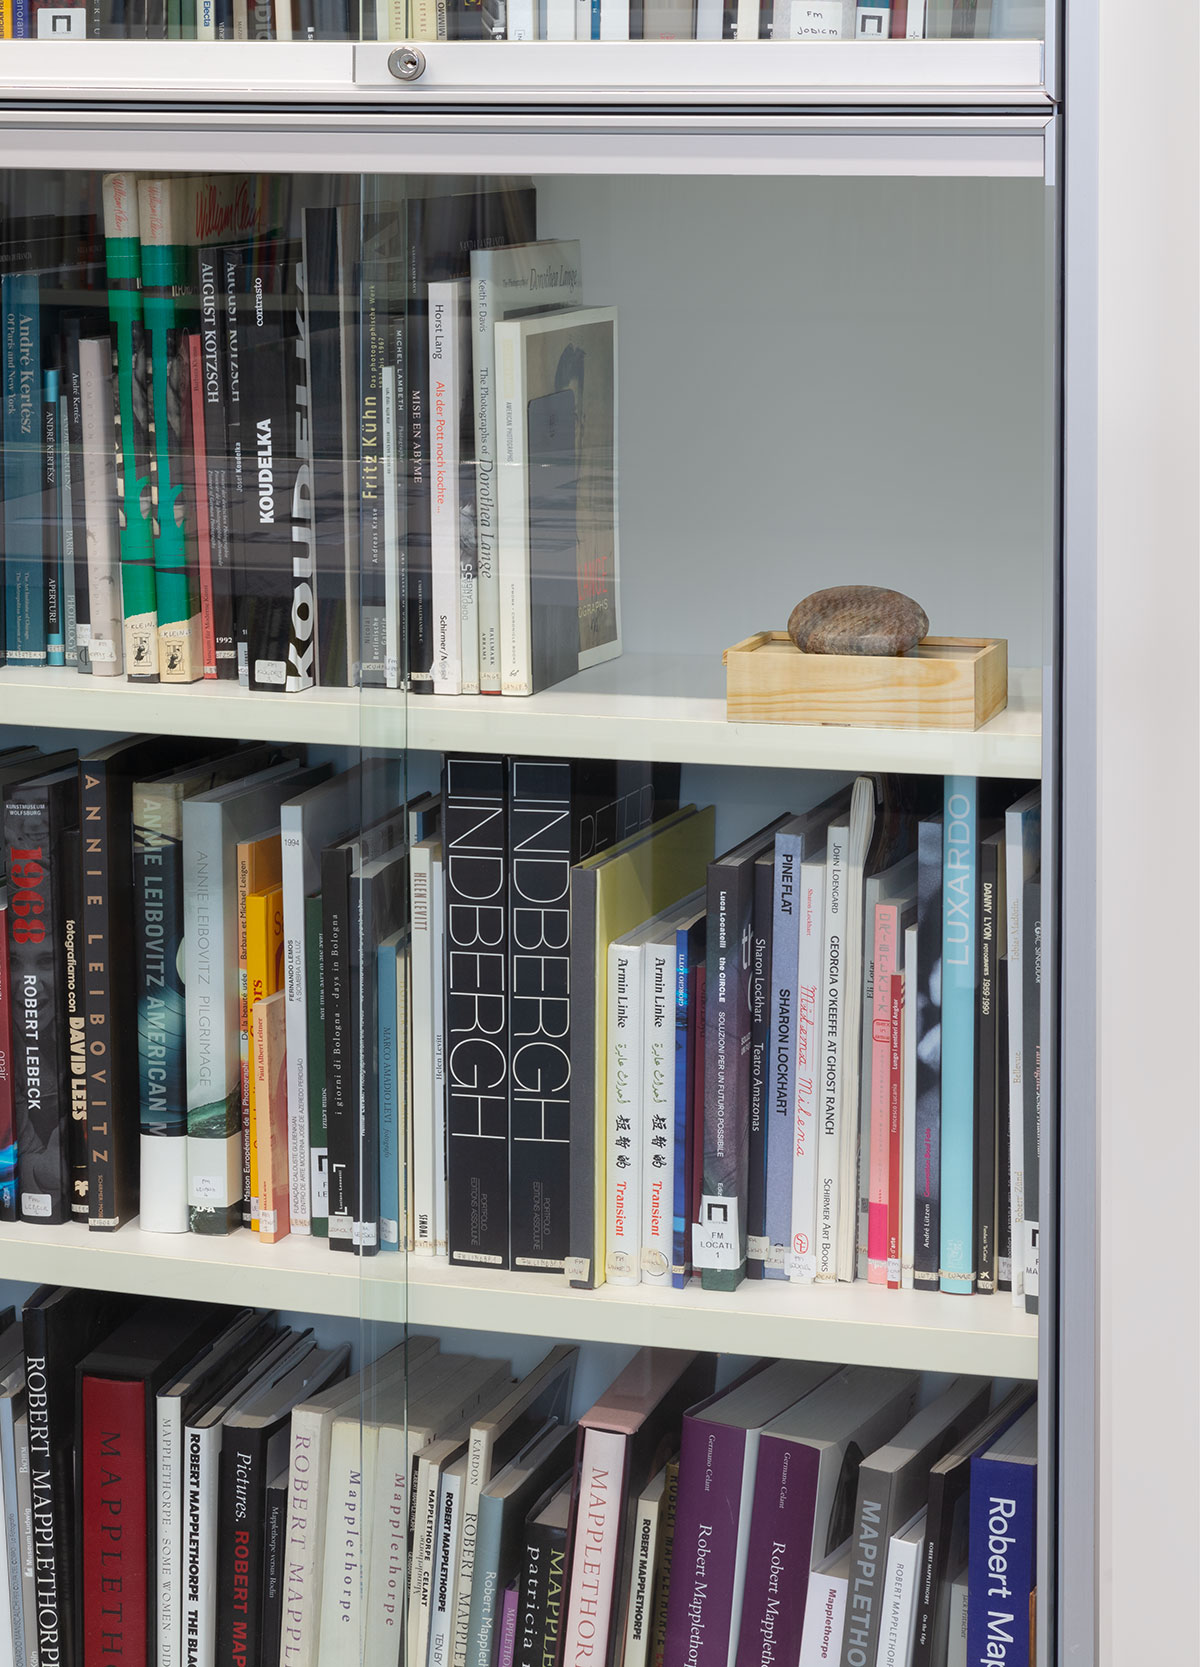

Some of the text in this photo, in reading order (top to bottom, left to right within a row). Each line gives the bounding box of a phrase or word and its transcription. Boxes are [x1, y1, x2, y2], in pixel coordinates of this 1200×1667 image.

[438, 2, 446, 36] MIMMO
[202, 262, 220, 402] AUGUST KOTZSCH
[433, 304, 444, 360] Horst Lang
[478, 280, 487, 300] Keith
[480, 310, 488, 332] Davis
[20, 313, 34, 434] André Kertész
[234, 442, 244, 492] Josef Koudelka
[257, 418, 275, 524] KOUDELKA
[412, 390, 422, 484] MISE EN ABYME
[478, 368, 494, 578] The Photographs of Dorothea Lange
[10, 846, 46, 944] 1968
[284, 839, 300, 847] 1994
[947, 794, 970, 966] LUXARDO
[84, 774, 108, 1164] ANNIE LEIBOVITZ
[143, 799, 167, 1112] ANNIE LEIBOVITZ AMERICAN
[448, 759, 506, 1140] LINDBERGH
[513, 762, 571, 1144] LINDBERGH
[23, 974, 42, 1110] ROBERT LEBECK
[64, 920, 88, 1122] fotografiamo con DAVID LEES
[776, 989, 790, 1116] SHARON LOCKHART
[825, 935, 840, 1135] GEORGIA O'KEEFFE AT GHOST RANCH
[615, 1181, 627, 1237] Transient
[651, 1181, 663, 1237] Transient
[821, 1178, 834, 1272] SCHIRMER ART BOOKS
[779, 1452, 792, 1510] Germano Celant
[340, 1470, 362, 1624] Mapplethorpe
[384, 1473, 405, 1626] Mapplethorpe
[820, 1588, 838, 1660] Mapplethorpe
